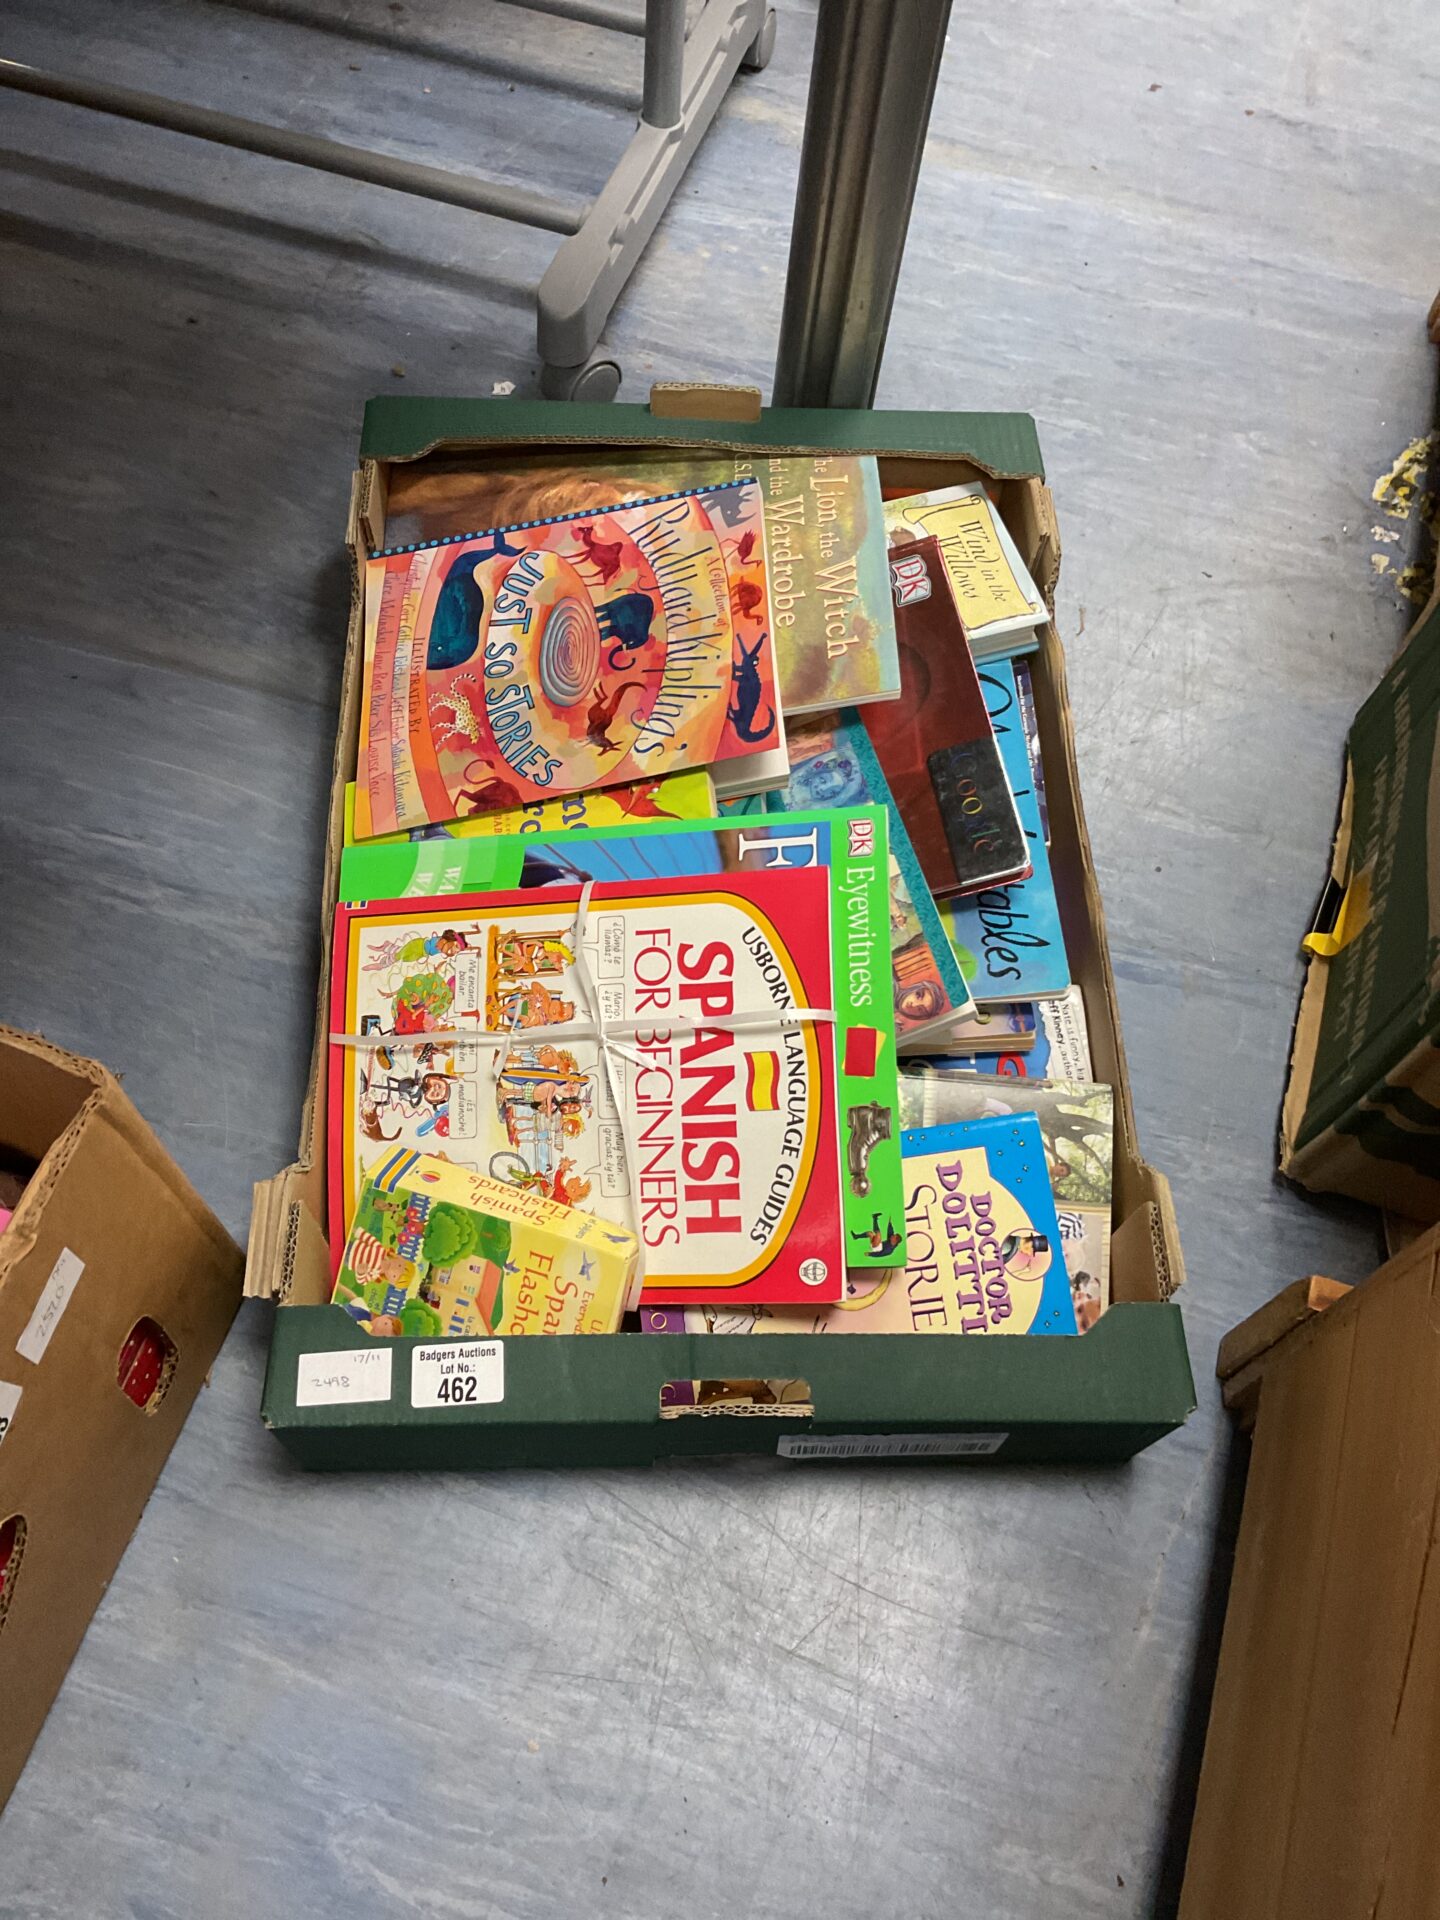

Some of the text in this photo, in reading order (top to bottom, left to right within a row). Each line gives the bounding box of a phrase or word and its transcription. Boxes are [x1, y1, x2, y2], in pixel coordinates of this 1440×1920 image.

[769, 475, 789, 496] the
[809, 474, 850, 528] Lion,
[764, 494, 806, 628] Wardrobe
[819, 531, 840, 558] the
[959, 520, 1011, 602] Wind in the
[383, 571, 402, 596] Clare
[401, 553, 427, 600] Christopher
[895, 559, 929, 601] DK
[938, 534, 981, 599] Willows
[705, 556, 730, 629] A Collection of
[814, 555, 860, 659] Witch
[374, 599, 397, 645] Melinsky
[398, 624, 413, 653] Cathie
[627, 497, 723, 757] Rudyard Kipling's
[373, 648, 393, 671] Jane
[408, 637, 426, 713] ILLUSTRATED
[483, 551, 563, 787] JUST SO STORIES
[370, 672, 389, 691] Ray
[369, 694, 388, 717] Peter
[390, 695, 406, 714] Jeff
[391, 715, 405, 738] Fisher
[368, 737, 387, 770] Louise
[392, 739, 407, 768] Satoshi
[369, 771, 388, 796] Voce
[393, 769, 412, 818] Kitamura
[838, 822, 875, 1007] DK Eyewitness
[614, 956, 622, 965] te
[634, 928, 672, 1013] FOR
[467, 959, 476, 1009] Me encanta
[1062, 1004, 1071, 1025] Nate
[1067, 1027, 1074, 1035] is
[1061, 1051, 1073, 1079] author
[677, 941, 742, 1235] SPANISH
[783, 1028, 807, 1159] LANGUAGE
[468, 1175, 572, 1220] Flashcards
[470, 1192, 551, 1226] Spanish
[750, 1163, 795, 1247] GUIDES
[904, 1184, 948, 1332] STORIE
[969, 1191, 1013, 1324] DOCTOR
[419, 1347, 496, 1362] Badgers Auctions
[440, 1363, 476, 1375] Lot No.:
[311, 1375, 351, 1388] 2498
[437, 1376, 478, 1403] 462
